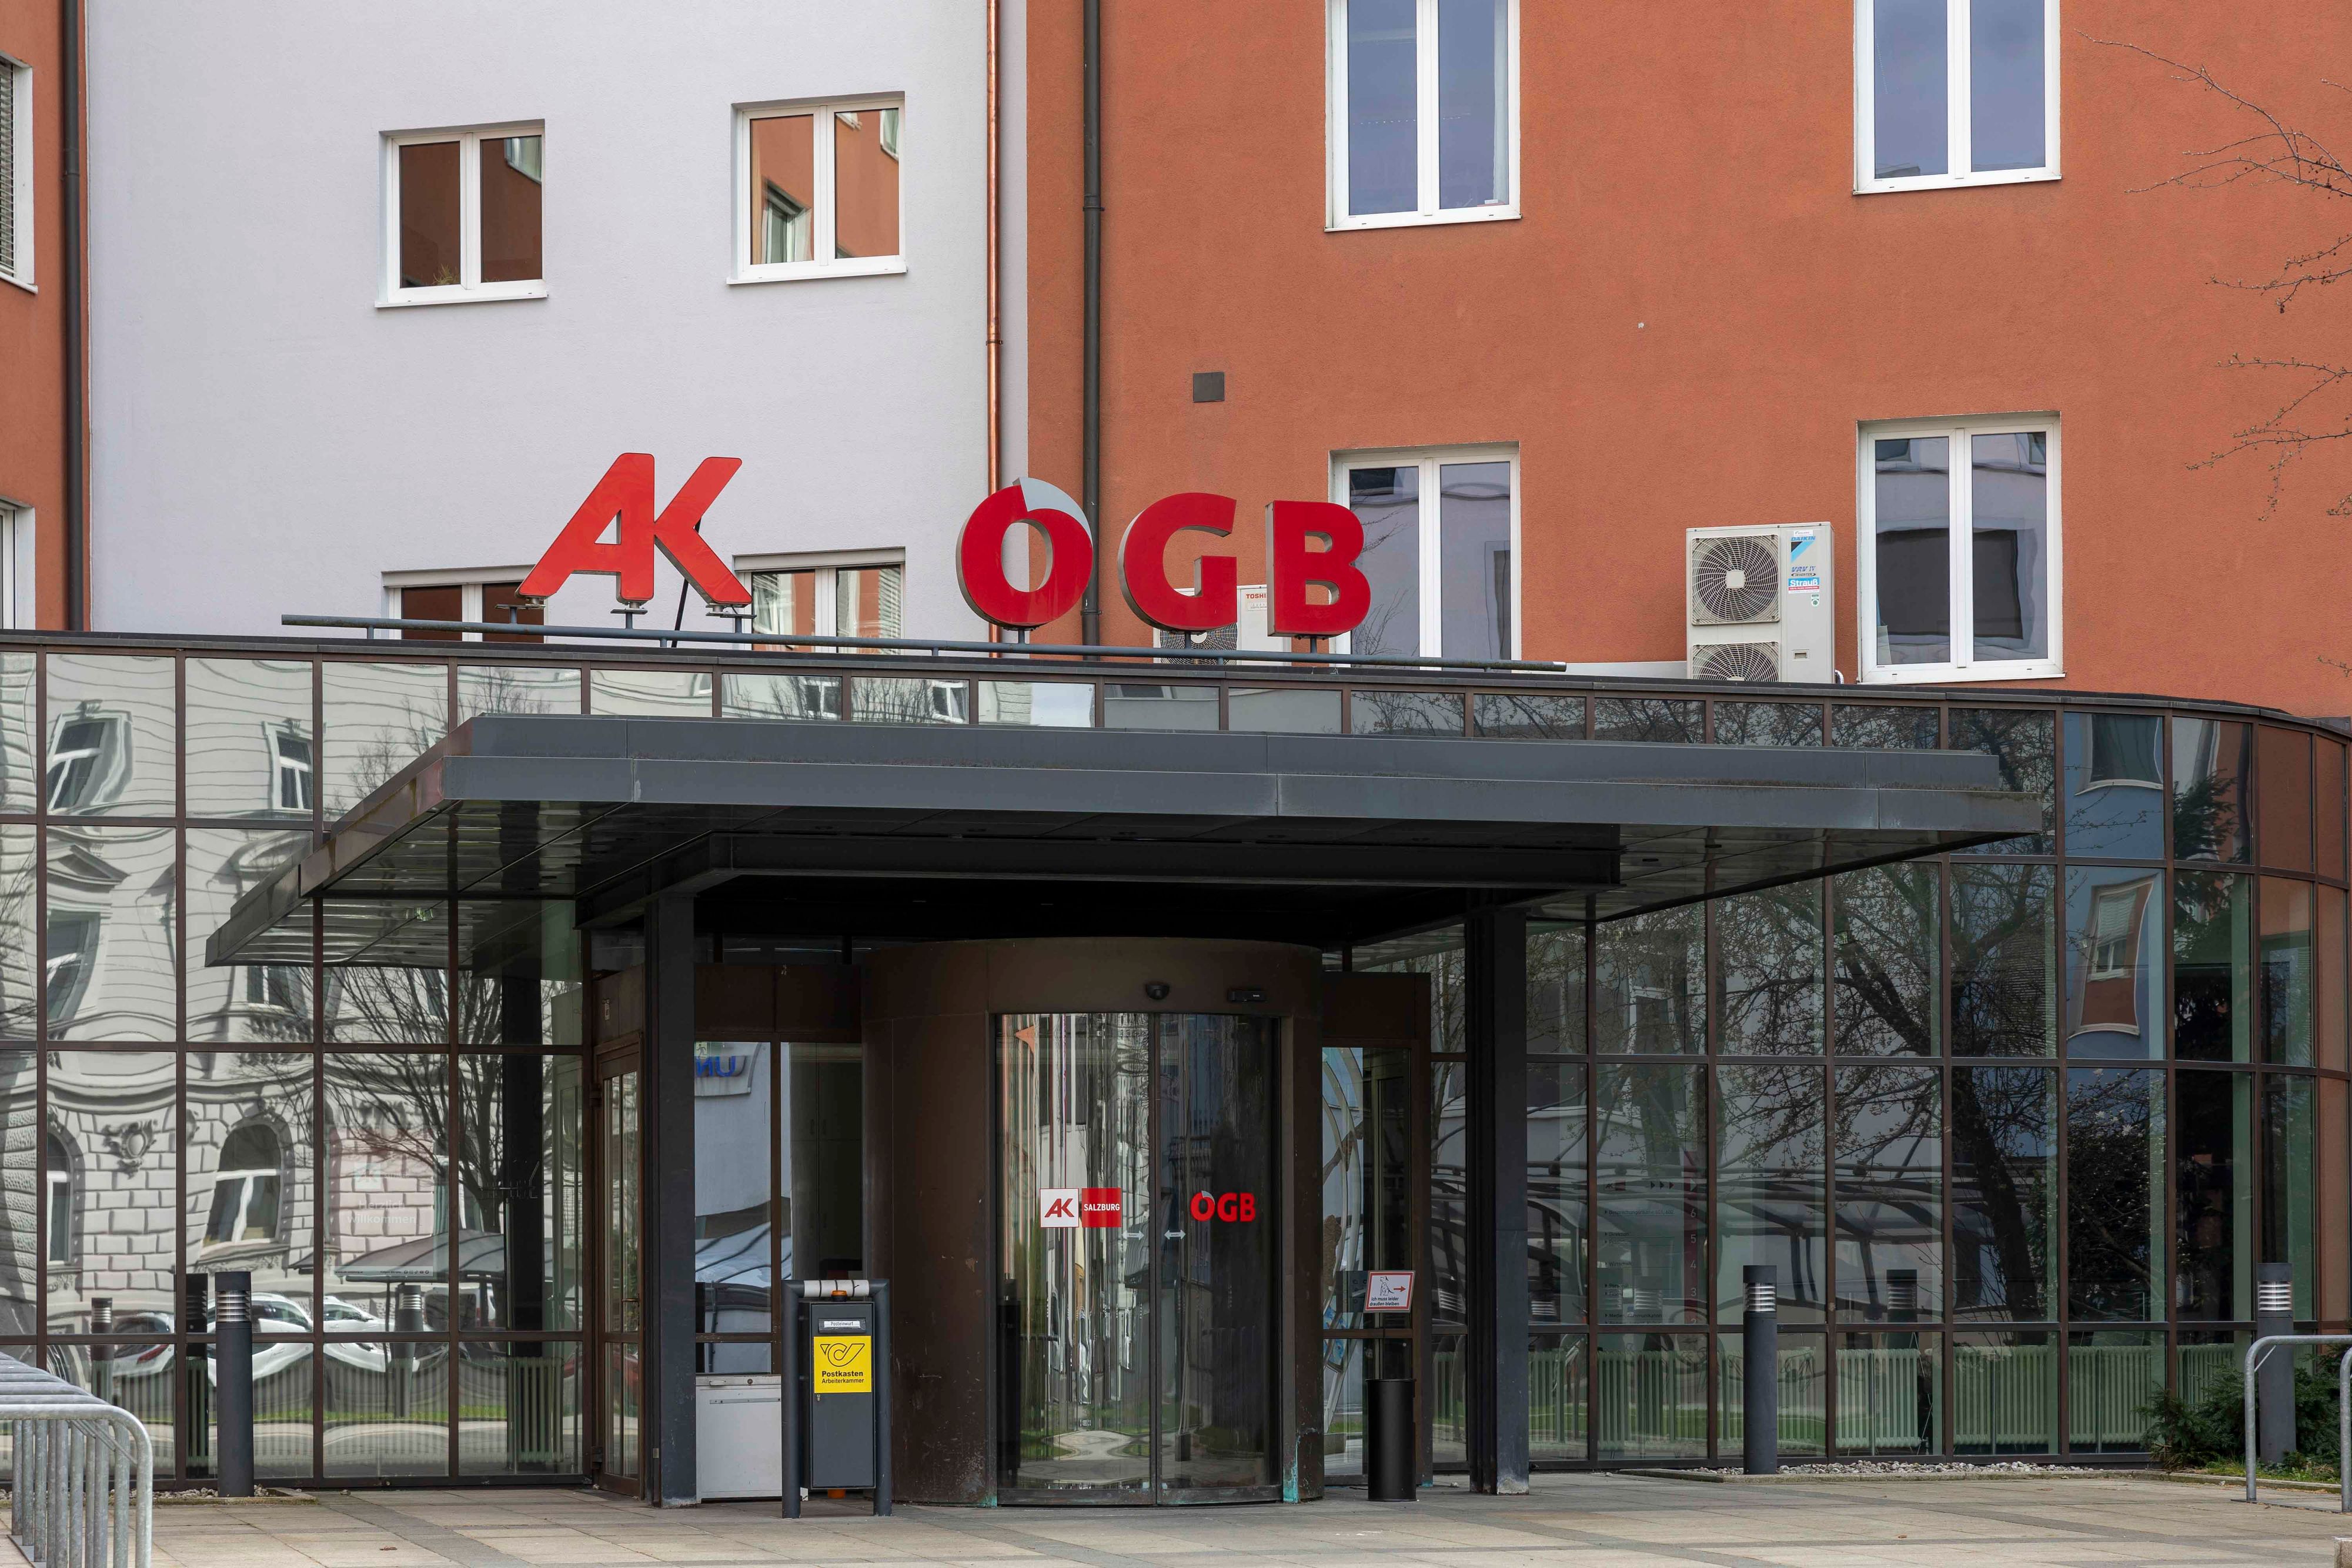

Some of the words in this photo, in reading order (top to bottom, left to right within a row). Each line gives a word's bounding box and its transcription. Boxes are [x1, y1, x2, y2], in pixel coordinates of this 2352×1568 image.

[515, 452, 753, 607] AK
[1789, 578, 1818, 587] Strauß
[359, 1199, 405, 1209] Herzlich
[1044, 1198, 1075, 1218] AK
[1084, 1203, 1120, 1212] SALZBURG
[1690, 1208, 1696, 1218] 6
[347, 1215, 416, 1223] willkommen
[1690, 1234, 1696, 1243] 5
[1690, 1260, 1696, 1269] 4
[1690, 1288, 1696, 1296] 3
